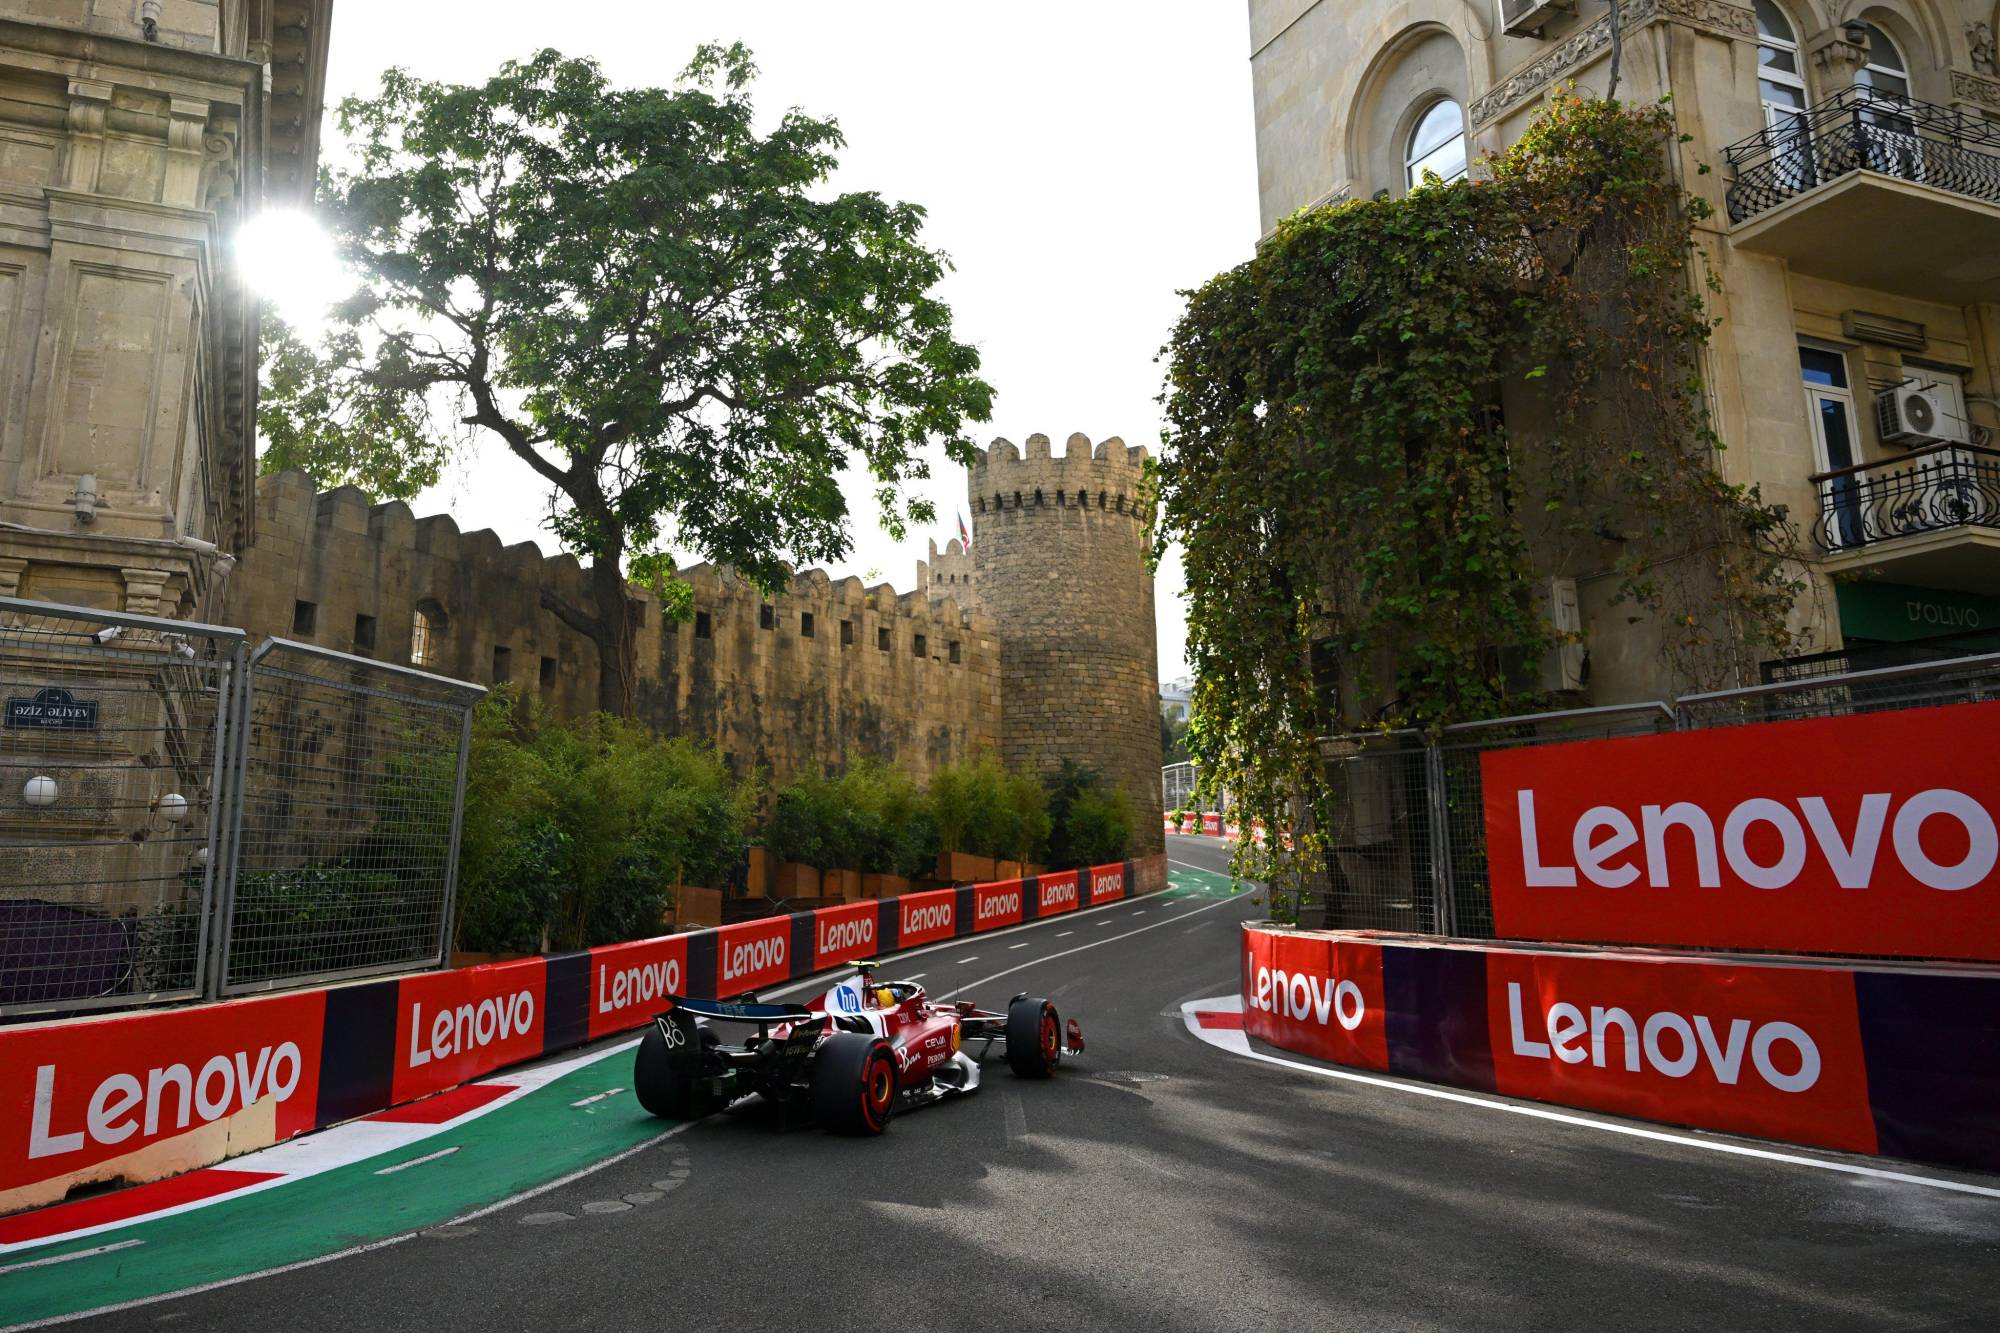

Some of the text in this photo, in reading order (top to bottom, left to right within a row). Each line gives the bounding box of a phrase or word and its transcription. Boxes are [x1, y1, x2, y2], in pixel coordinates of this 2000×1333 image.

[15, 706, 89, 718] ƏZİZ ƏLİYEV
[1518, 788, 1999, 891] Lenovo
[1041, 882, 1076, 907] Lenovo
[1093, 873, 1122, 896] Lenovo
[903, 903, 951, 935] Lenovo
[978, 892, 1019, 920] Lenovo
[819, 917, 873, 955] Lenovo
[723, 935, 785, 981] Lenovo
[599, 959, 680, 1014] Lenovo
[1248, 952, 1365, 1031] Lenovo
[409, 990, 534, 1068] Lenovo
[1508, 982, 1821, 1093] Lenovo
[898, 1046, 921, 1073] -Ban
[28, 1041, 302, 1159] Lenovo
